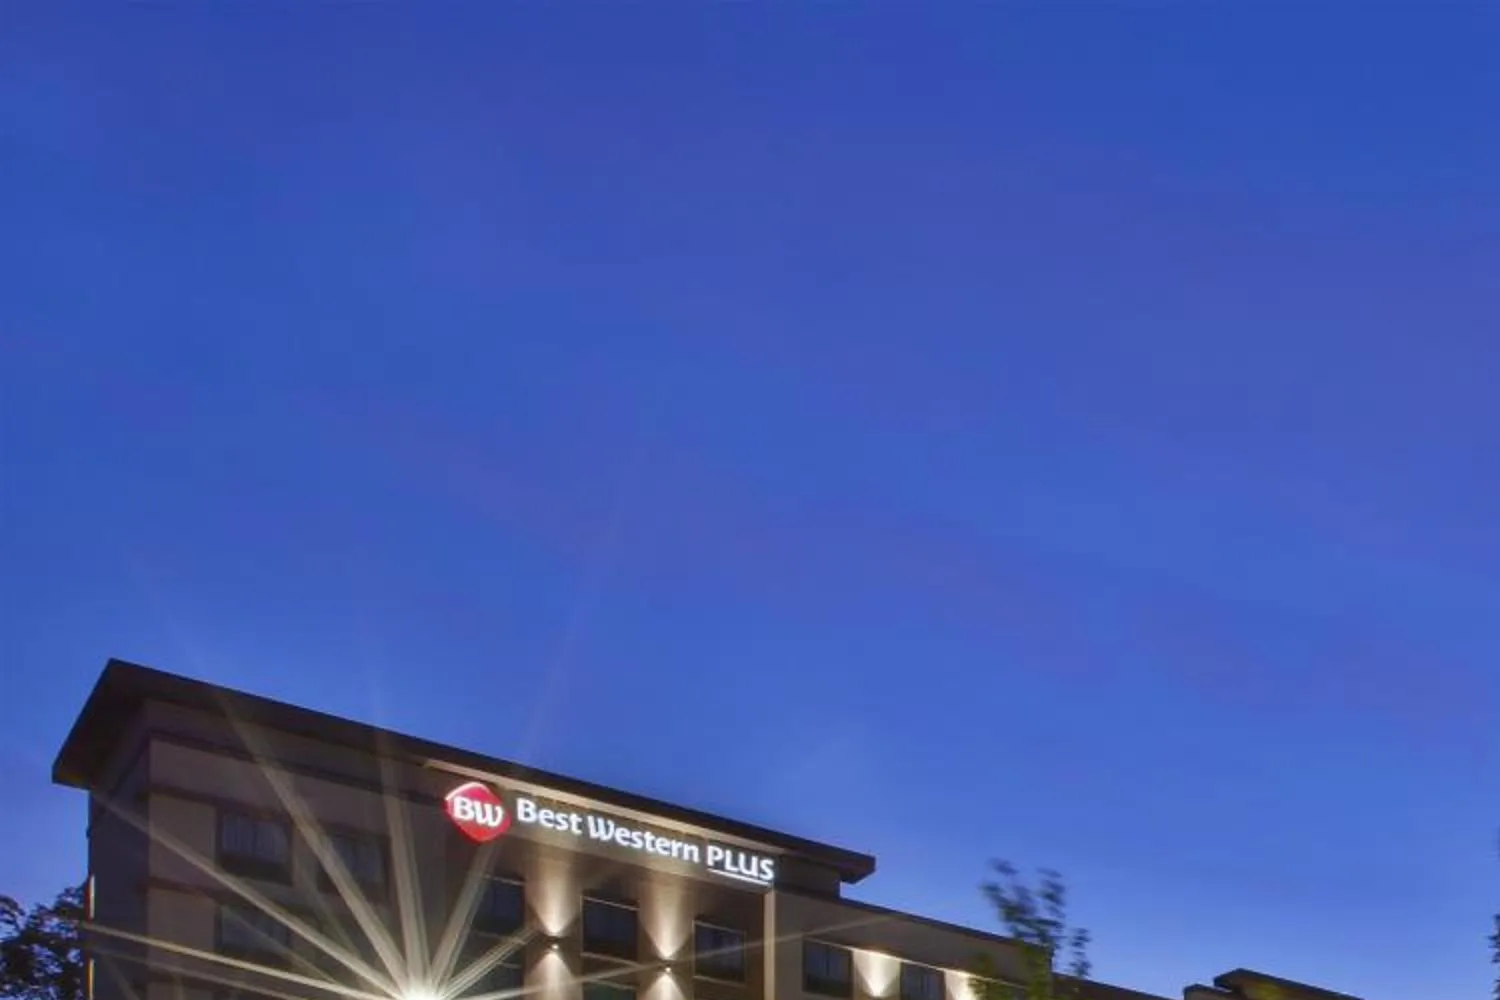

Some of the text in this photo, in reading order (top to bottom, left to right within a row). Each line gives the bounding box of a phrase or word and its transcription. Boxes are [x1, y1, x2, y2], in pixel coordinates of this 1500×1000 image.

[452, 795, 502, 828] BW
[515, 797, 774, 881] Best Western PLUS
